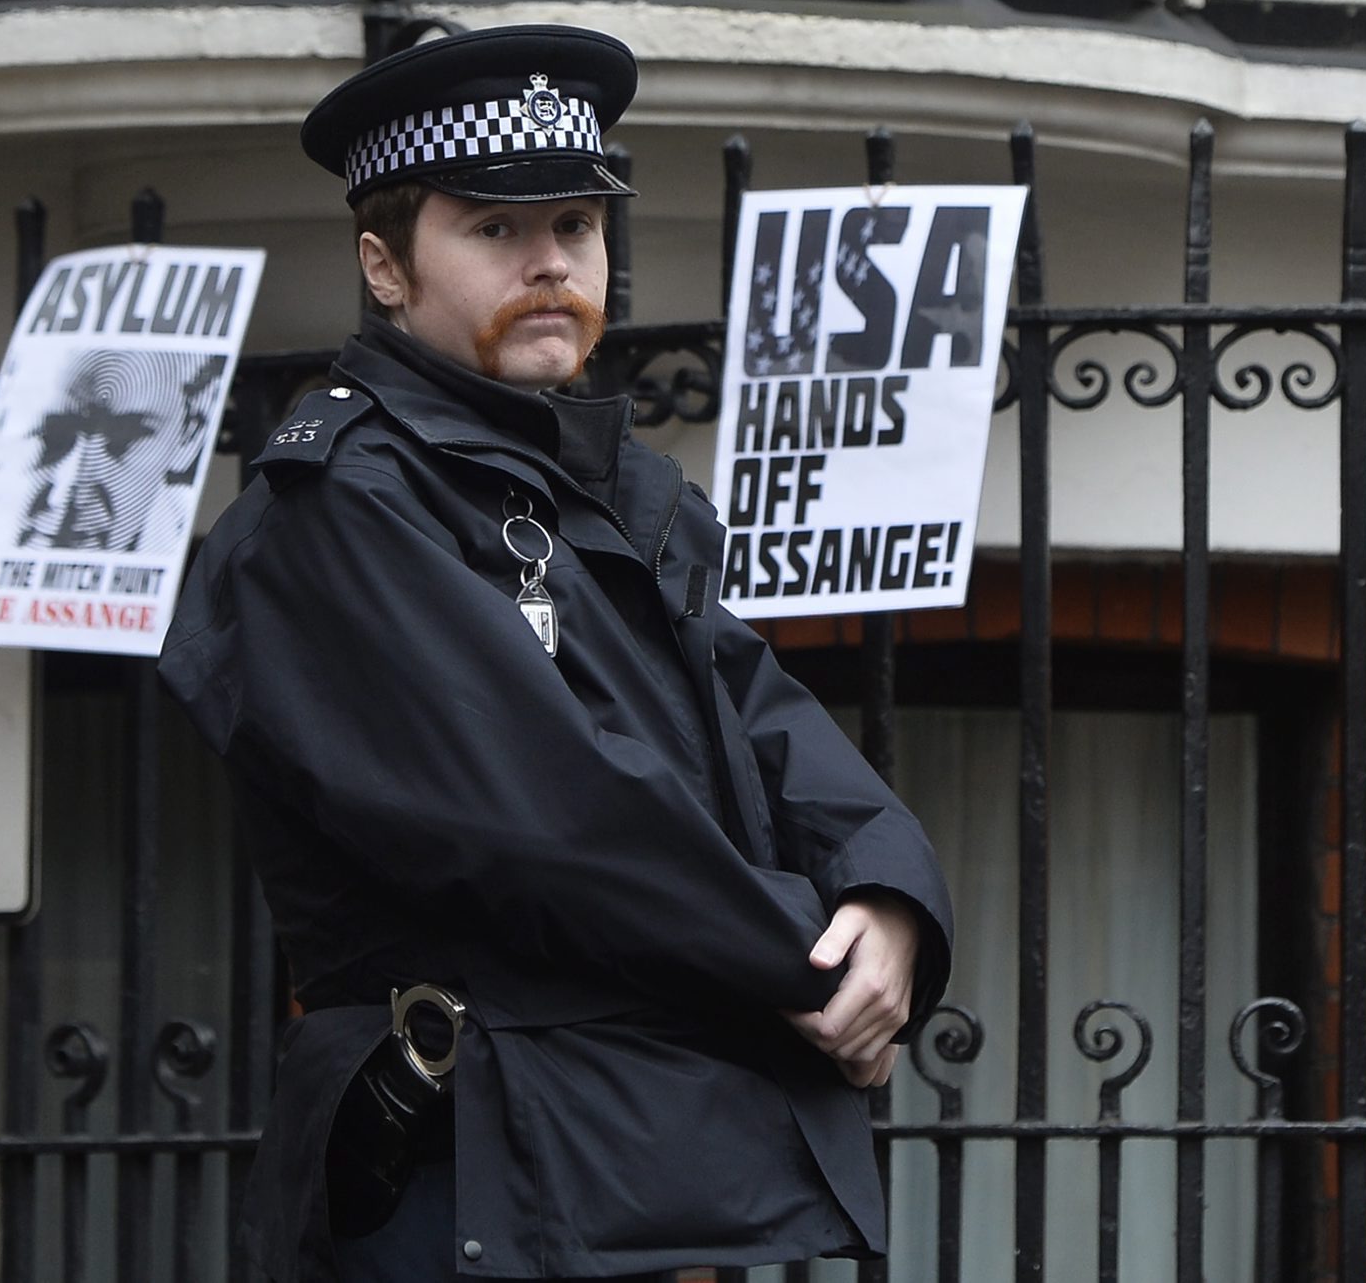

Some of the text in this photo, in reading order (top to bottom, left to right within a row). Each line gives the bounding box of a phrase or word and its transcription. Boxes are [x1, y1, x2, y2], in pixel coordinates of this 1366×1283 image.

[28, 260, 244, 338] ASYLUM
[744, 205, 992, 377] USA
[735, 375, 910, 452] HANDS
[729, 454, 826, 527] OFF
[40, 561, 106, 592] WITCH
[109, 565, 166, 596] HUNT
[722, 522, 962, 600] ASSANGE!
[25, 598, 158, 632] ASSANGE
